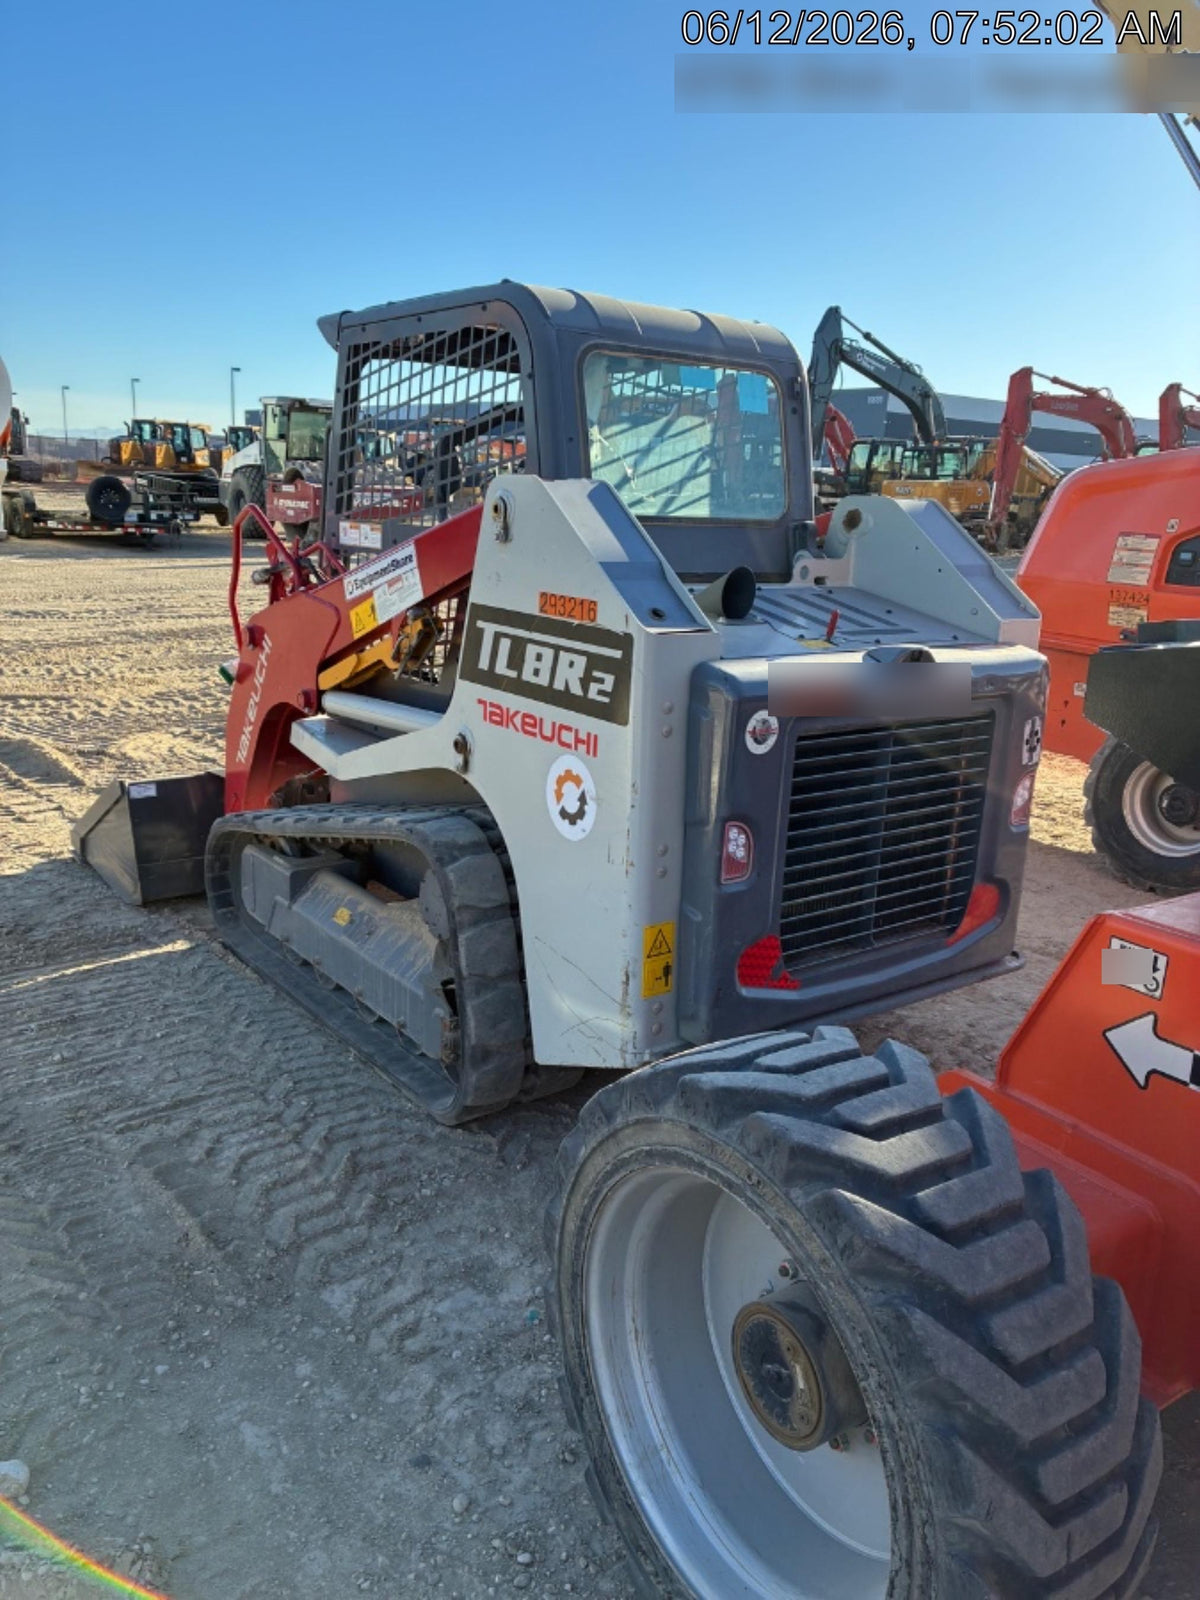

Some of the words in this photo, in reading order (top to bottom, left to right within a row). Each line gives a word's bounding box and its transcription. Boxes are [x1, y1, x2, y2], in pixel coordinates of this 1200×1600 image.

[353, 554, 414, 591] EquipmentShare
[539, 591, 598, 623] 293216
[1109, 588, 1151, 604] 137424
